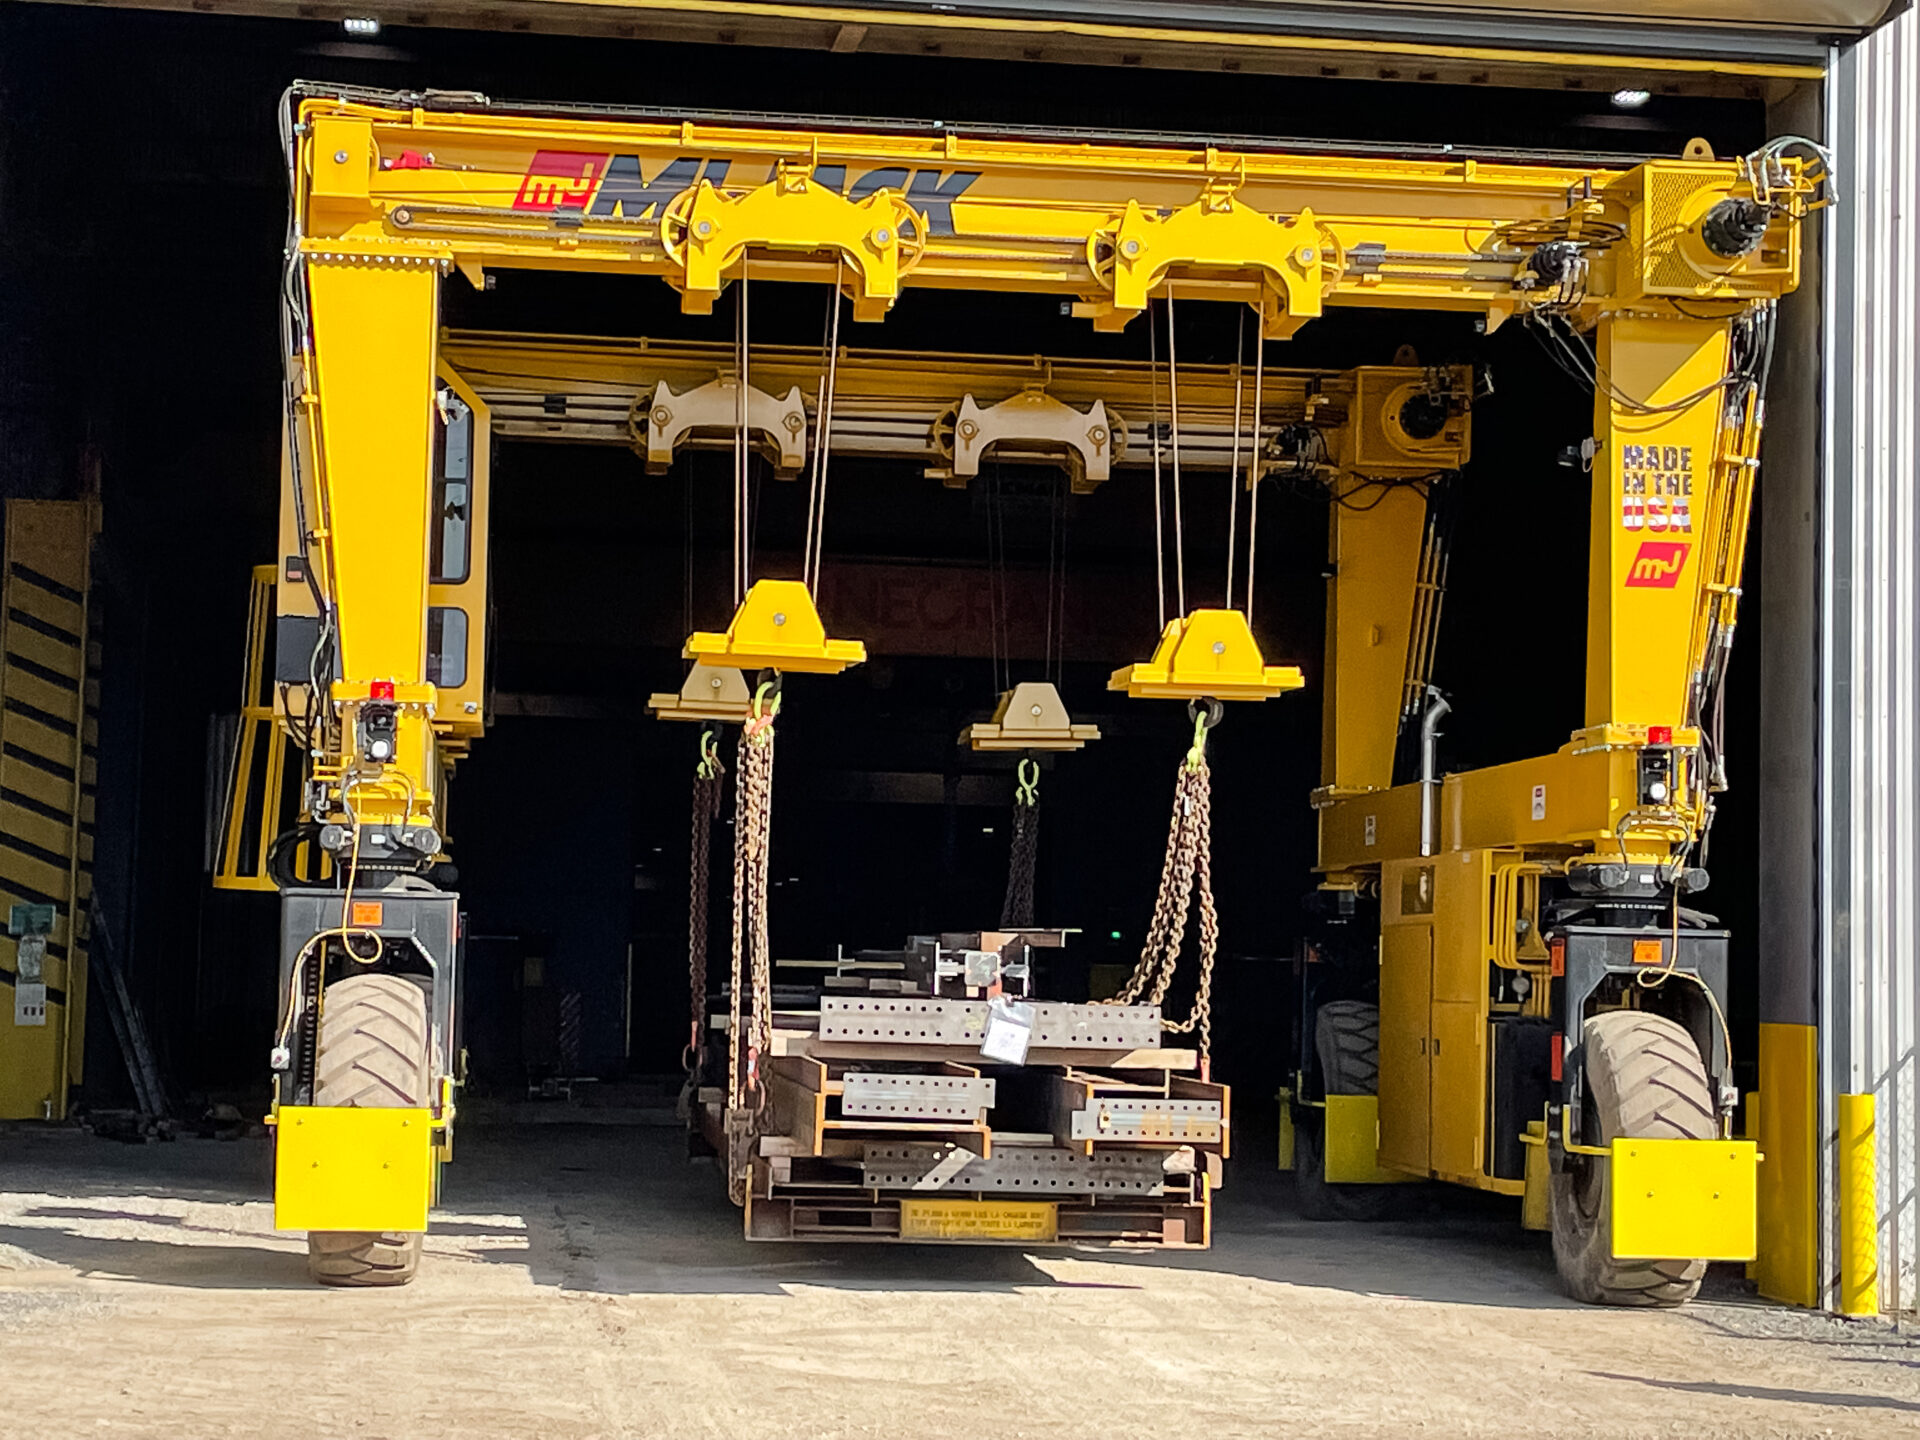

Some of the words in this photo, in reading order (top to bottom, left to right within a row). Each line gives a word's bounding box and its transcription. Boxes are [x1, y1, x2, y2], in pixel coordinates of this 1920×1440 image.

[1622, 444, 1693, 472] MADE
[1623, 472, 1647, 495] IN
[1652, 472, 1693, 496] THE
[1622, 496, 1693, 534] USA
